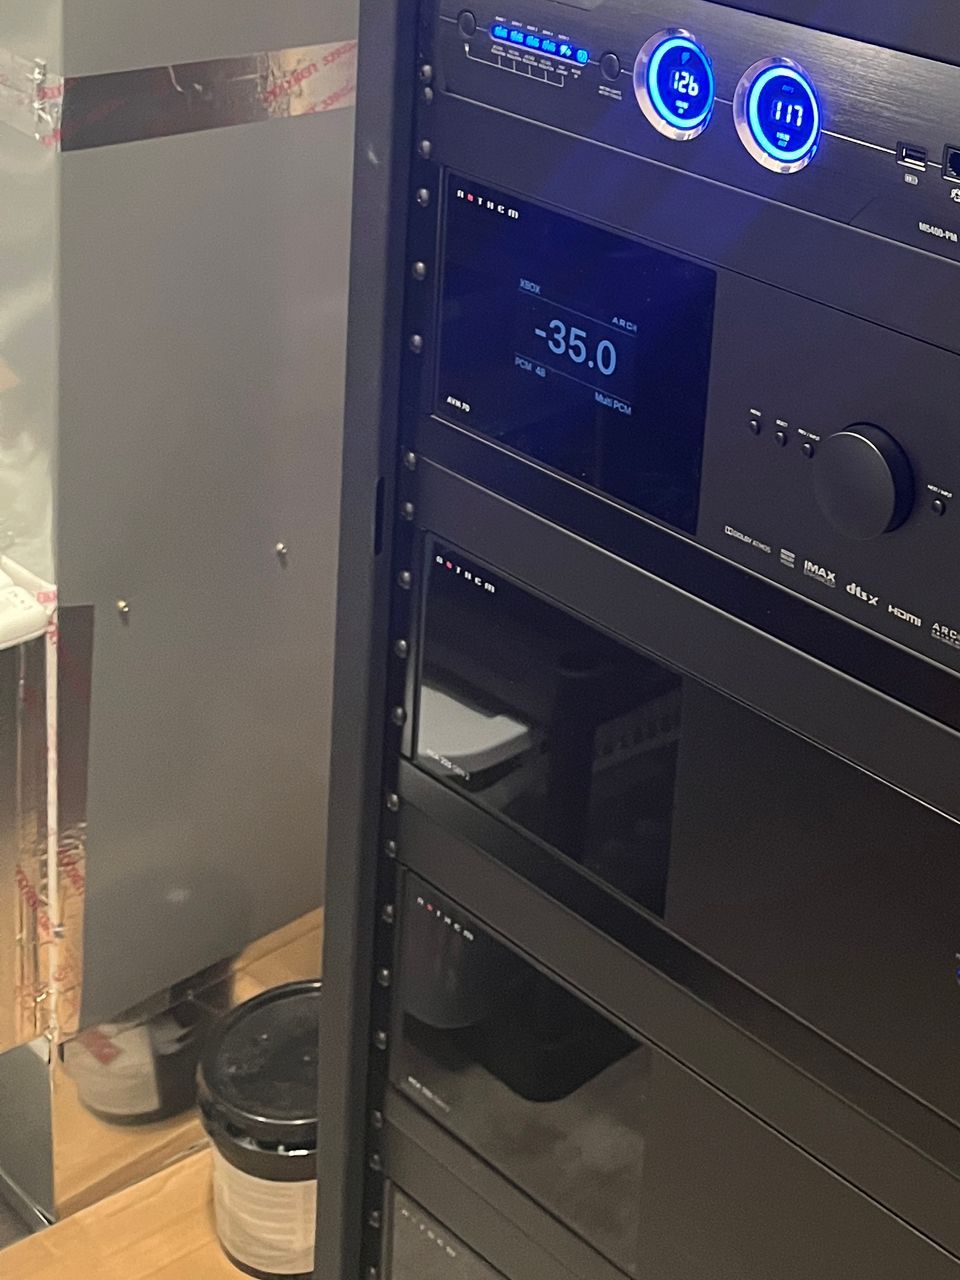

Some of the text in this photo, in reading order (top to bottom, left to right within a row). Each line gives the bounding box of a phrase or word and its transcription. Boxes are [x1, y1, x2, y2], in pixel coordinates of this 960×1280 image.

[456, 189, 519, 219] ANTHEM
[520, 278, 541, 295] XBOX
[534, 319, 617, 376] -35.0
[514, 356, 532, 371] PCM
[613, 399, 632, 416] PCM
[804, 560, 836, 583] IMAX
[888, 604, 922, 627] HDMI
